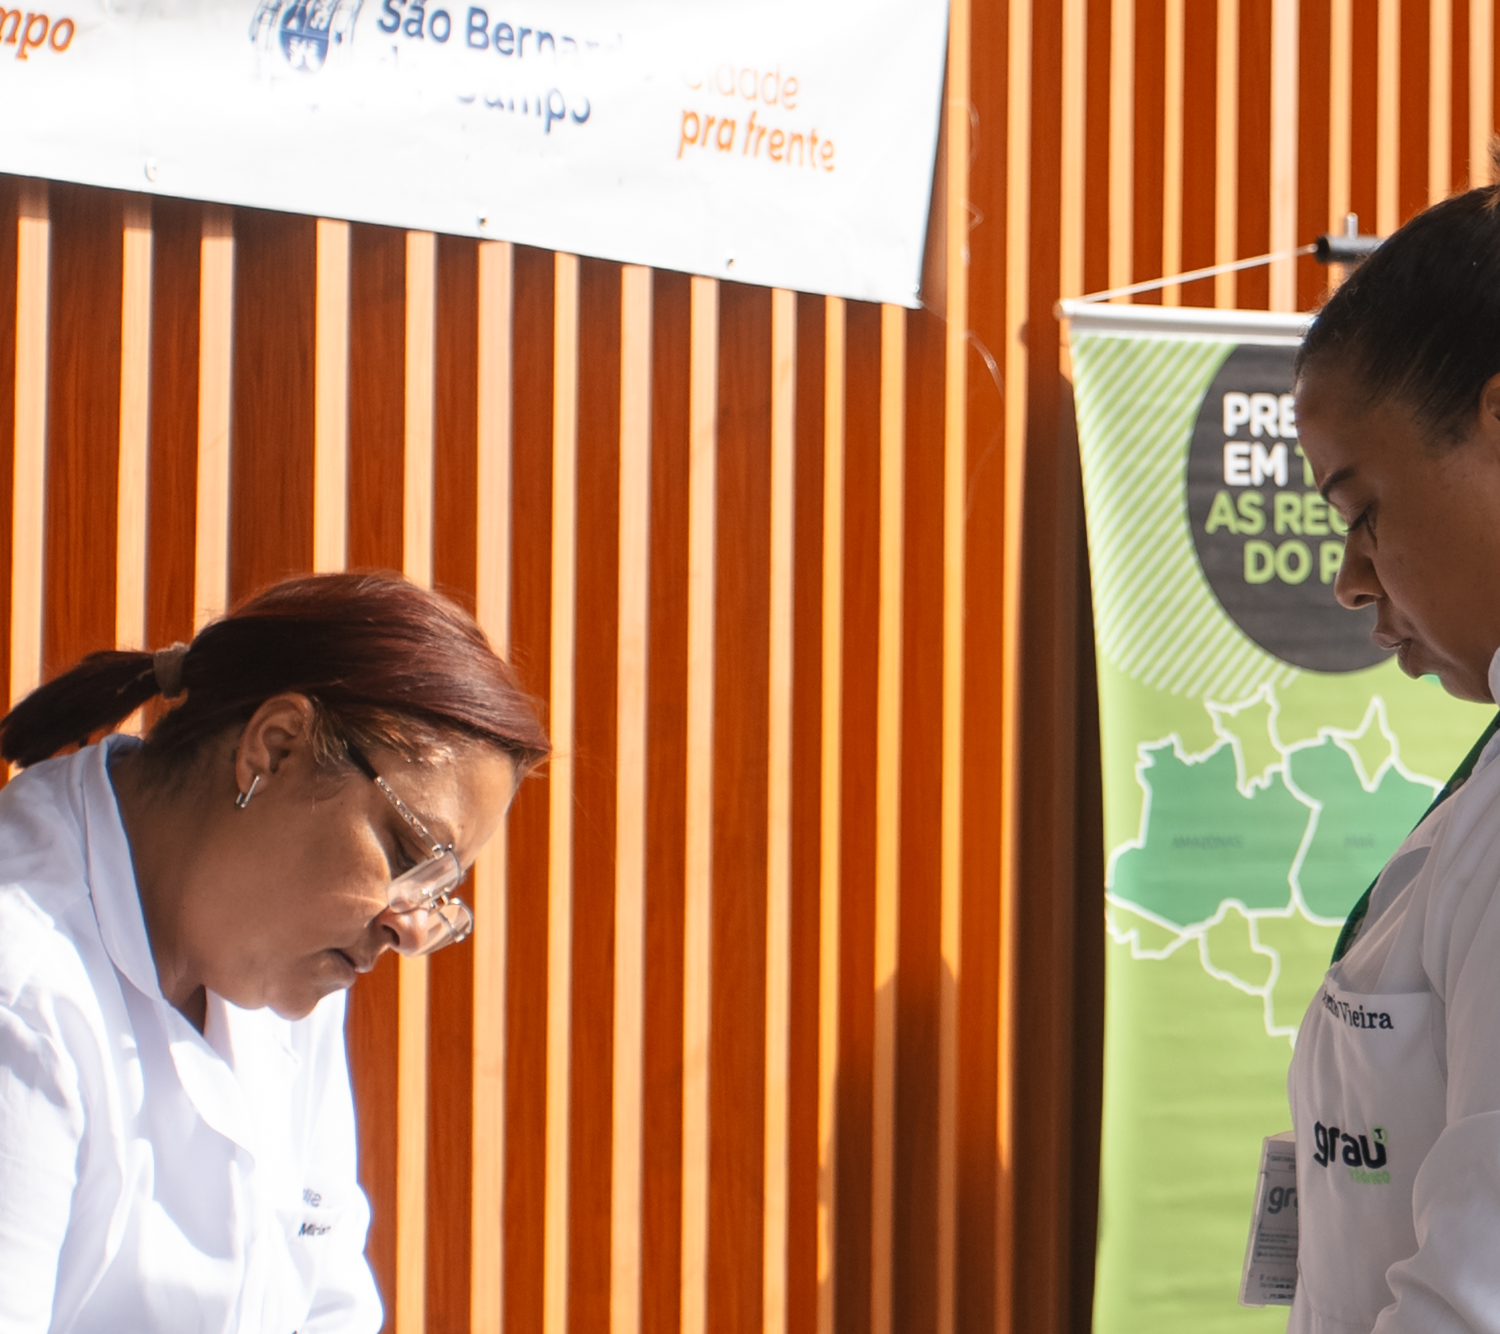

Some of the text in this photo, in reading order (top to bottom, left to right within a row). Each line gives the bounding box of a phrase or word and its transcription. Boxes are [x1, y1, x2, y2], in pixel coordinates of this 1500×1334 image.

[676, 108, 836, 173] pra frente
[1222, 391, 1299, 438] PRE
[1222, 441, 1289, 488] EM
[1204, 489, 1267, 536] AS
[1243, 539, 1313, 585] DO
[1337, 1001, 1395, 1030] Vieira
